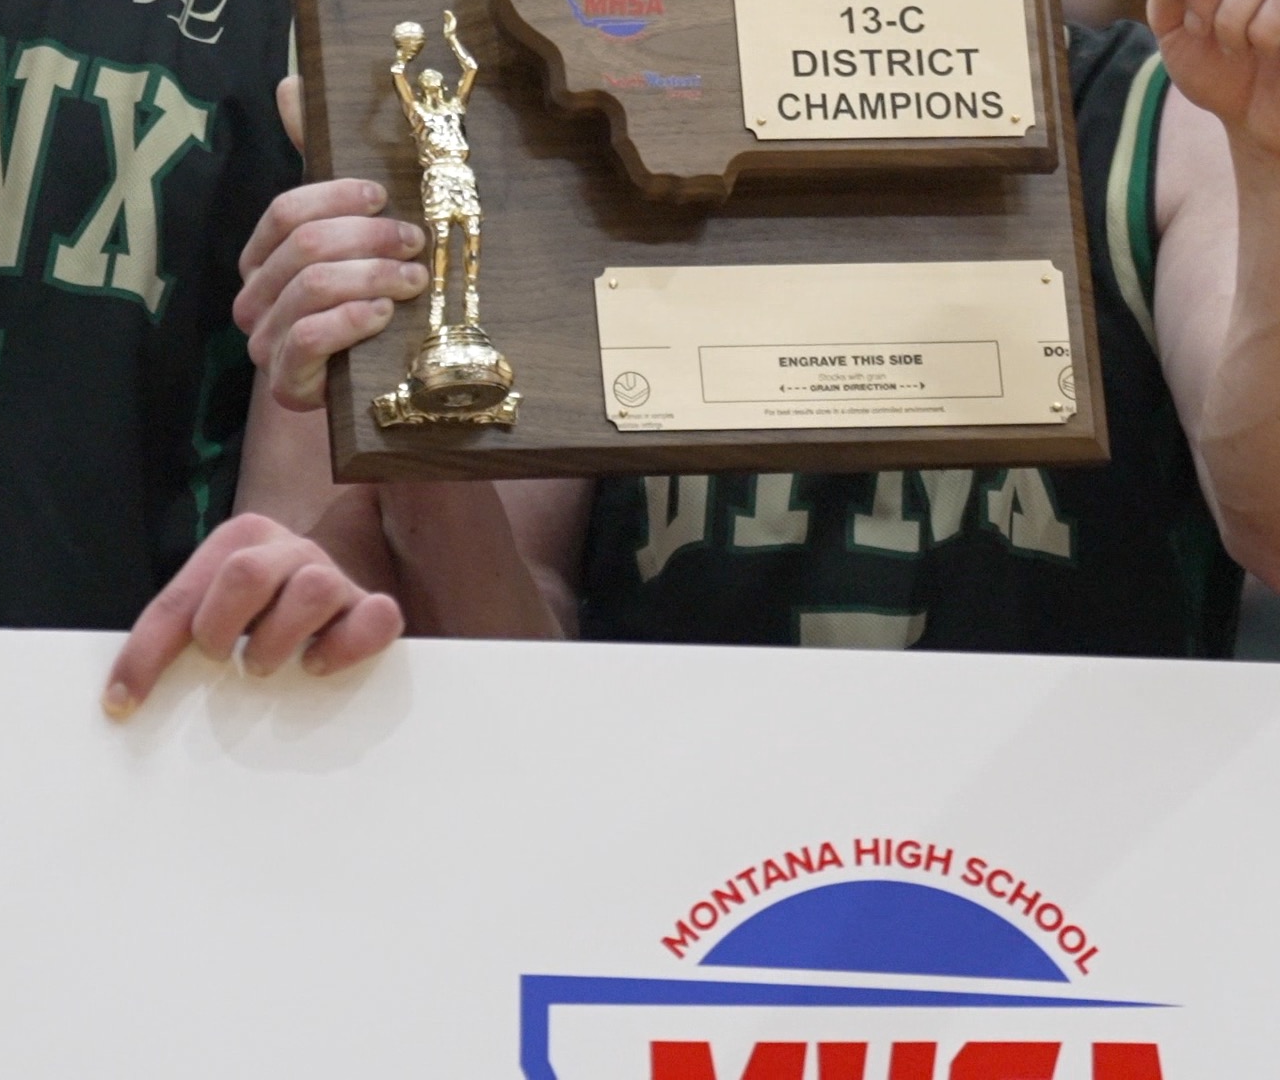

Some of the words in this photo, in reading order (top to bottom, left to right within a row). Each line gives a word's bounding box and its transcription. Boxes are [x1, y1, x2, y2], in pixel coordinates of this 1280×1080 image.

[840, 5, 925, 35] 13-C
[791, 48, 980, 78] DISTRICT
[777, 90, 1004, 121] CHAMPIONS
[779, 356, 847, 367] ENGRAVE
[851, 355, 885, 366] THIS
[889, 354, 924, 365] SIDE
[1043, 346, 1070, 357] DO:
[809, 384, 840, 392] GRAIN
[843, 383, 897, 391] DIRECTION
[661, 841, 844, 958] MONTANA
[853, 838, 954, 876] HIGH
[960, 856, 1100, 975] SCHOOL
